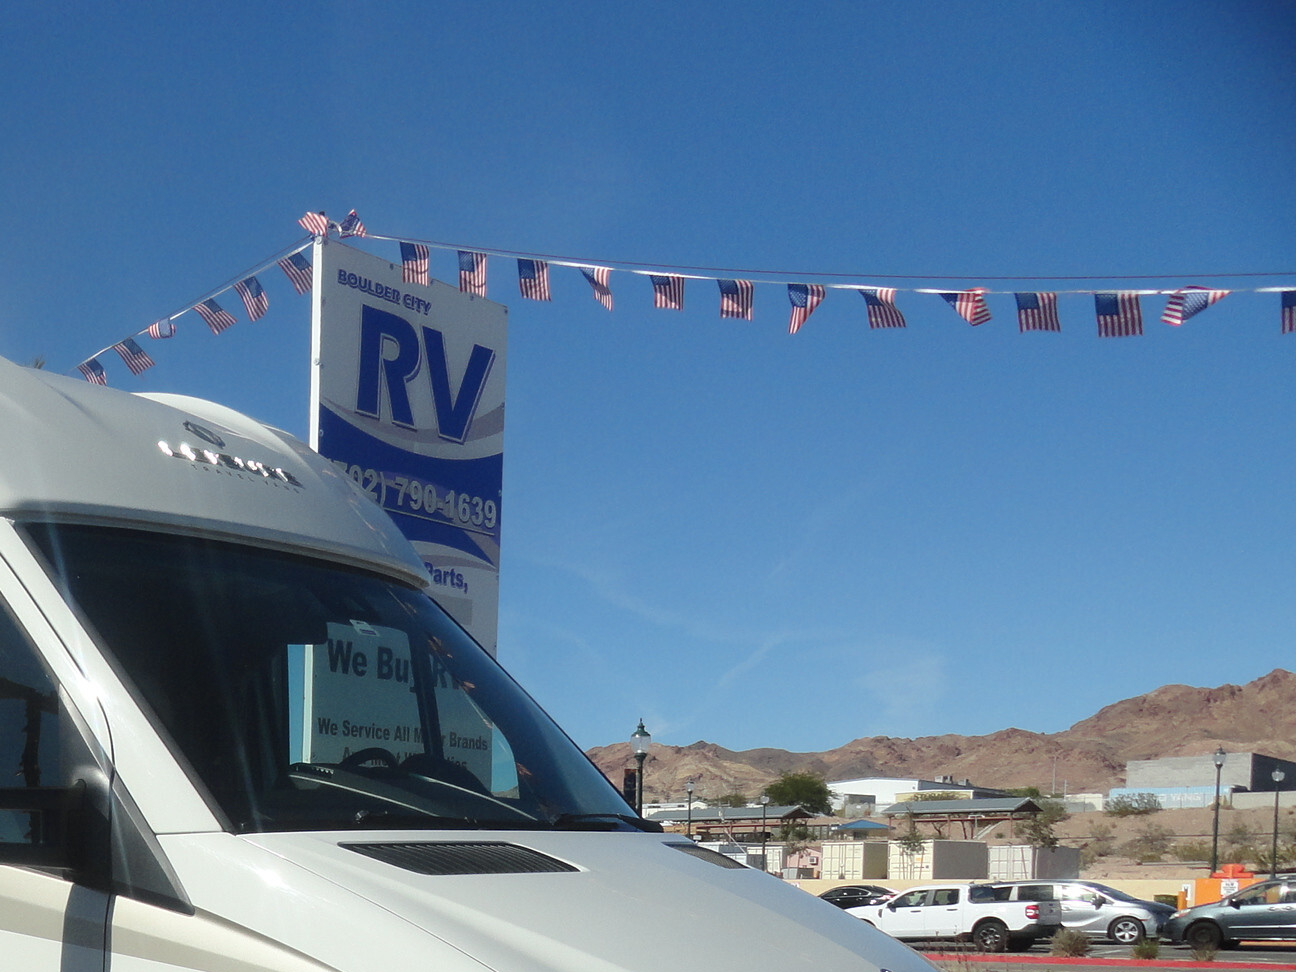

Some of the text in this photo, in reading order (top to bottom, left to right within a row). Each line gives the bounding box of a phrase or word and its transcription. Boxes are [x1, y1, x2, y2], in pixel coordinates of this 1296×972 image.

[337, 268, 432, 316] BOULDER CITY
[355, 303, 496, 444] RV
[395, 476, 497, 529] 790-1639
[327, 638, 368, 678] We
[377, 646, 417, 694] Bu
[318, 717, 339, 736] We
[342, 719, 390, 741] Service
[394, 725, 410, 743] All
[449, 731, 488, 751] Brands
